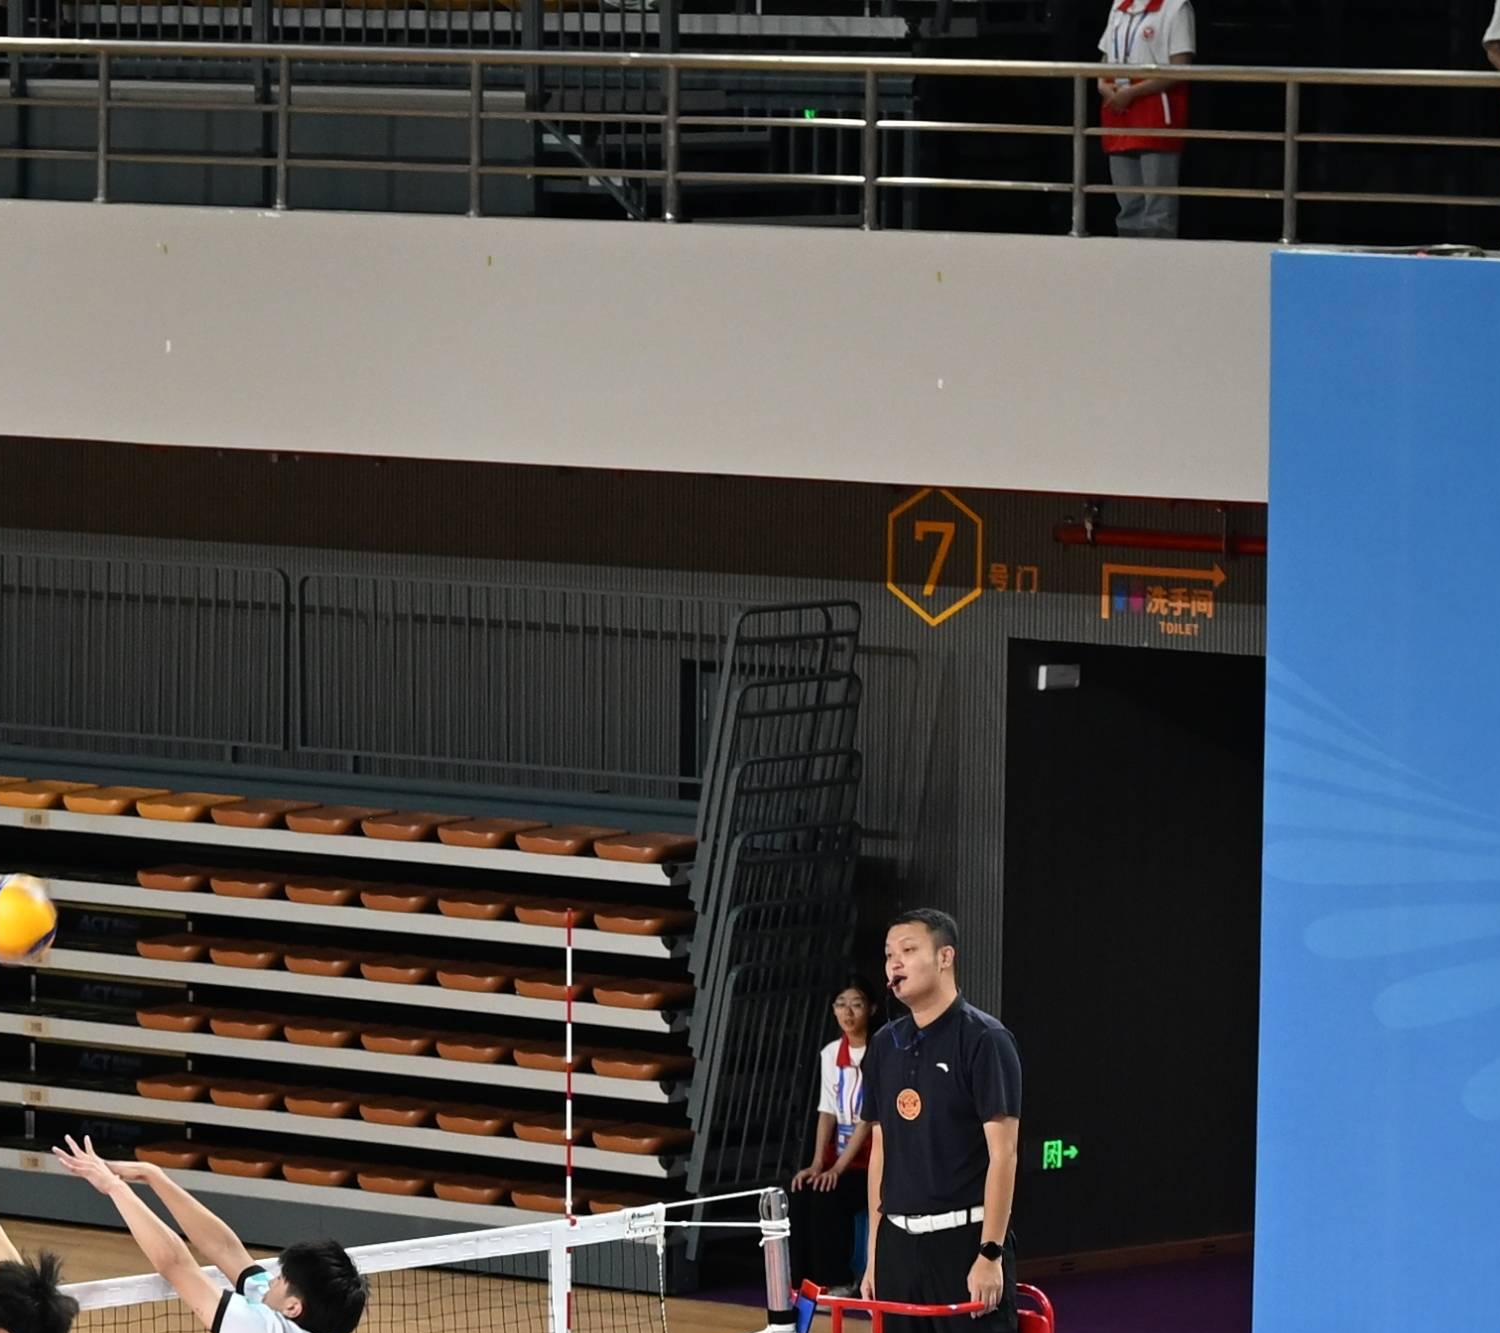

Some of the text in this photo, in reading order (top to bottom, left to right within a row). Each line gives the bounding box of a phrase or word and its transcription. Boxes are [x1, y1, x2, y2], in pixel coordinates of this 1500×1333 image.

[914, 521, 955, 596] 7
[1146, 585, 1213, 619] 洗手间
[1160, 621, 1199, 636] TOILET
